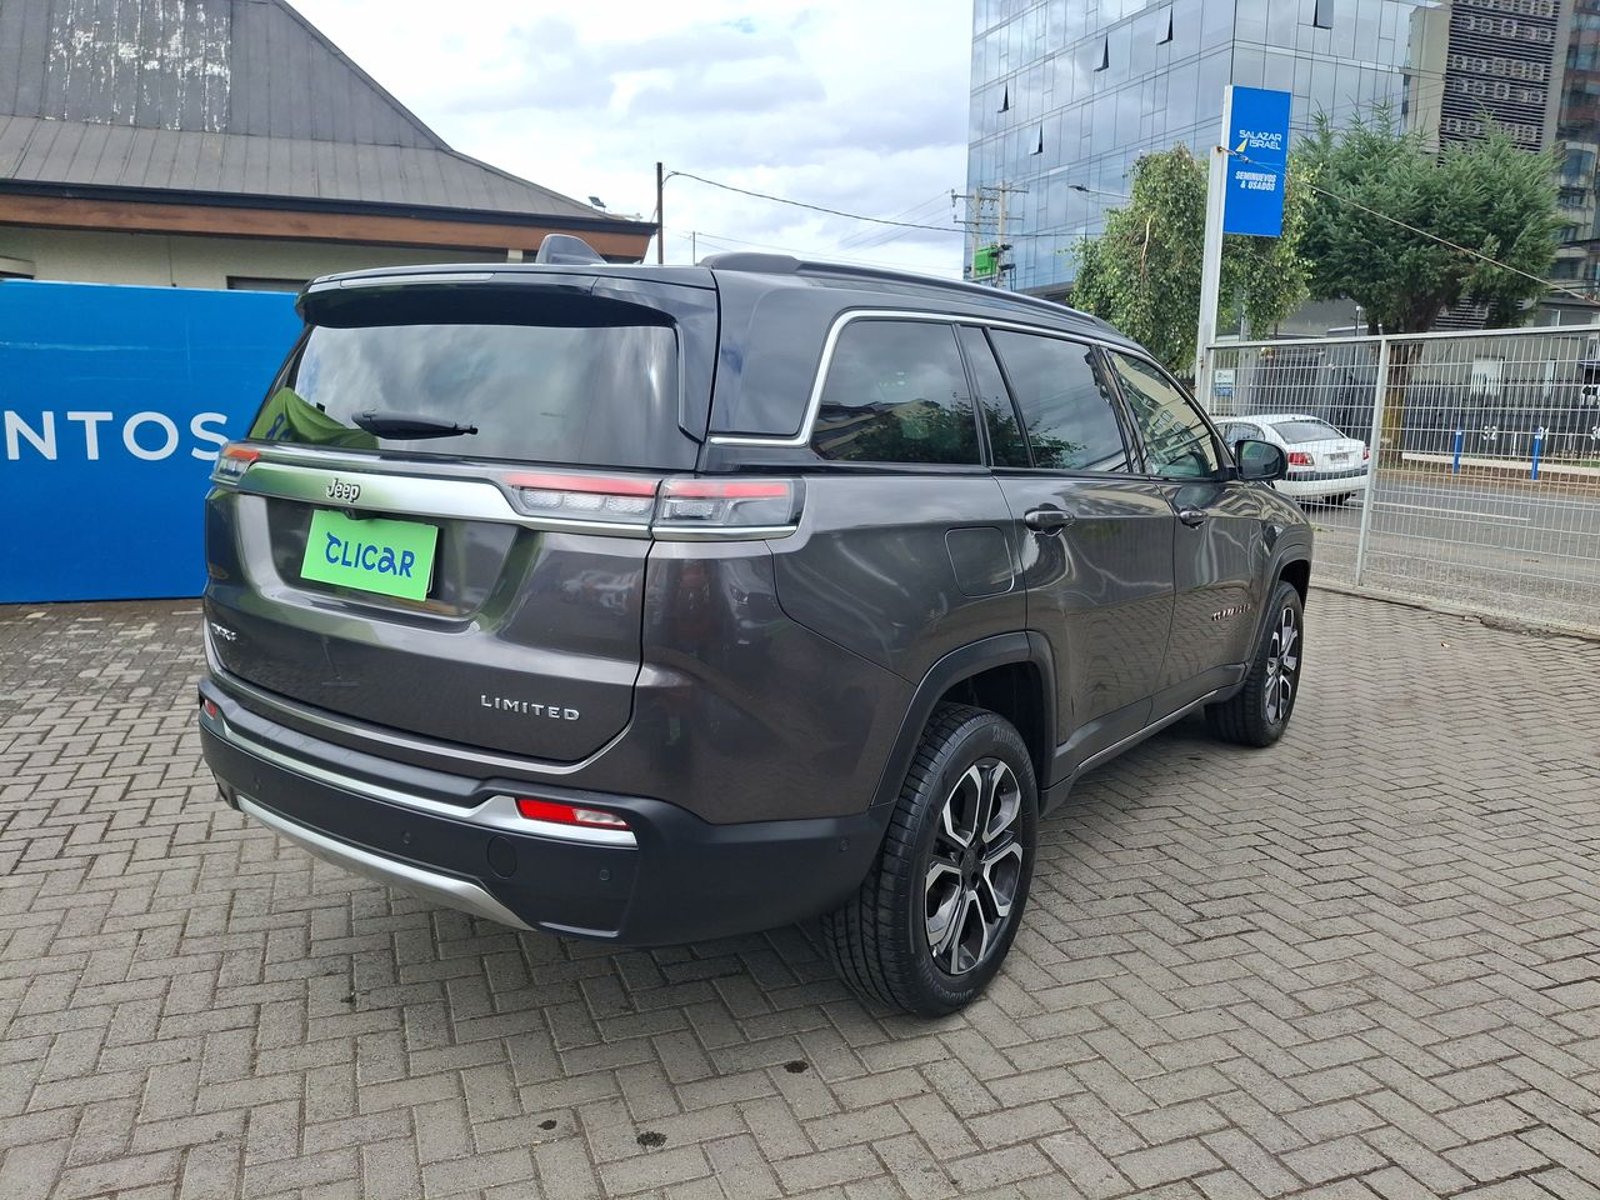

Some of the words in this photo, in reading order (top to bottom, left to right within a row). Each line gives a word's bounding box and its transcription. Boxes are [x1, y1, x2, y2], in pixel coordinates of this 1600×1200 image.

[1239, 129, 1282, 141] SALAZAR
[1249, 139, 1281, 150] ISRAEL
[1235, 170, 1277, 181] SEMINUEVOS
[1247, 181, 1275, 191] USADOS
[326, 478, 361, 503] Jeep
[480, 695, 580, 721] LIMITED
